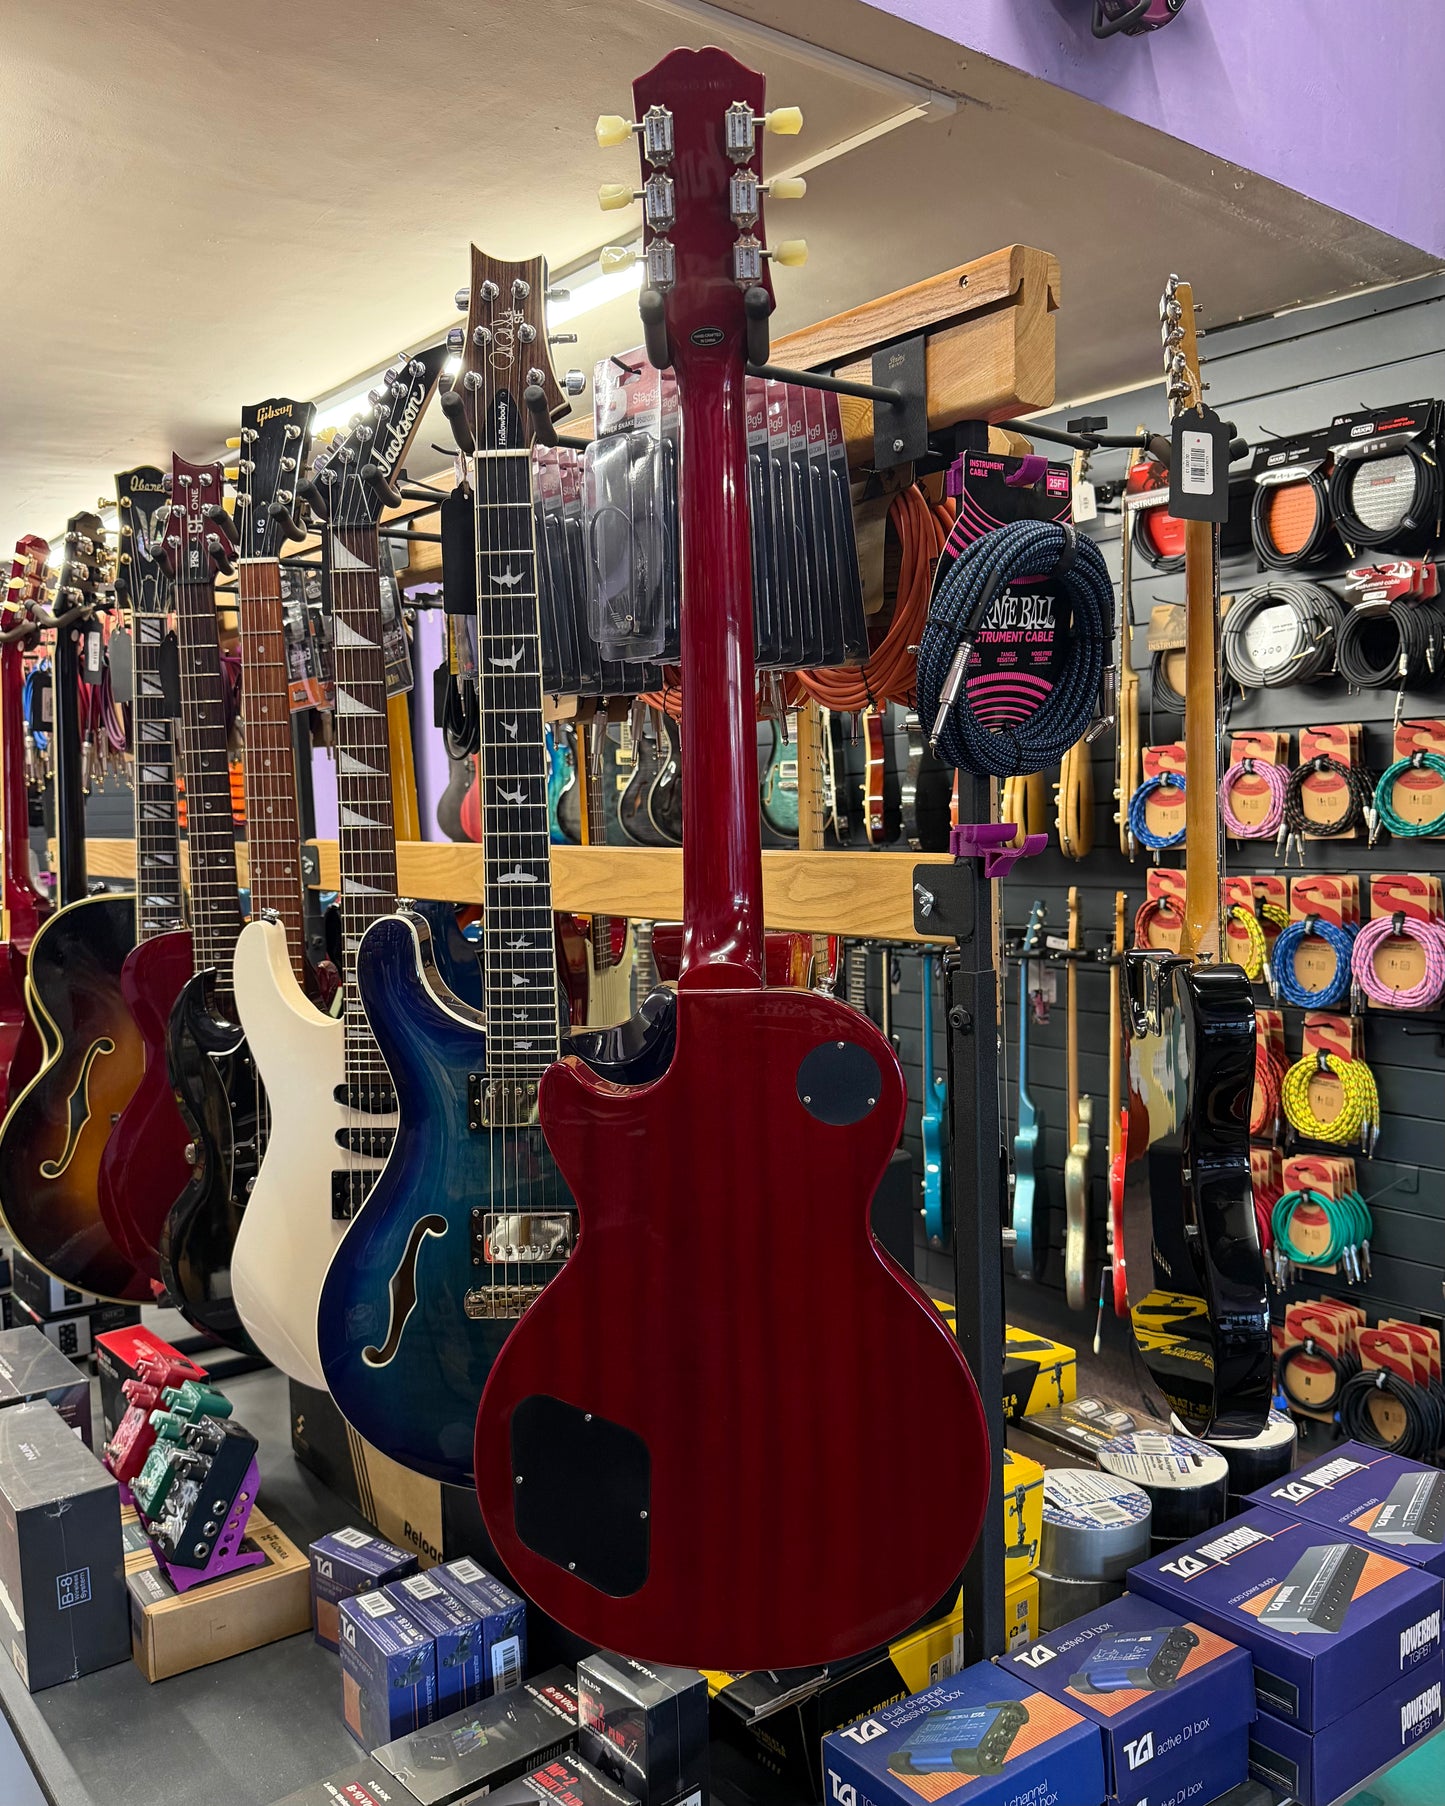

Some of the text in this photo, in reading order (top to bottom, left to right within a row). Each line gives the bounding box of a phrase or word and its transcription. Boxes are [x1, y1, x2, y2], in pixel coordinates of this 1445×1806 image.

[633, 388, 660, 407] Stagg
[256, 403, 293, 428] Gibson
[499, 401, 508, 446] Hollowbody
[371, 383, 426, 478] Jackson
[969, 459, 1005, 472] INSTRUMENT
[969, 468, 989, 478] CABLE
[1049, 478, 1066, 489] 25FT
[191, 488, 199, 511] ONE
[1127, 496, 1170, 511] INSTRUMEN
[257, 519, 266, 534] SG
[190, 551, 200, 569] PRS
[1017, 595, 1056, 630] BALL
[975, 631, 1055, 643] STRUMENT CABLE
[1270, 1481, 1315, 1502] TGI
[1351, 1505, 1365, 1517] power
[1364, 1497, 1380, 1509] supply
[315, 1554, 333, 1579] TGI
[1159, 1554, 1208, 1579] TGI
[61, 1575, 74, 1606] B-8
[80, 1571, 88, 1600] System
[1243, 1585, 1260, 1598] power
[1258, 1576, 1278, 1589] supply
[340, 1614, 357, 1649] TGI
[1013, 1644, 1058, 1668] TGI
[1056, 1634, 1085, 1654] active
[1091, 1622, 1114, 1637] box
[1409, 1644, 1432, 1665] TGIPB1
[628, 1659, 656, 1679] NUX
[564, 1683, 579, 1696] NU
[580, 1675, 602, 1694] NUX
[545, 1686, 578, 1712] B-10 Vlog
[881, 1687, 946, 1721] dual channel
[840, 1719, 889, 1745] TGI
[891, 1704, 931, 1729] passive
[941, 1690, 965, 1704] box
[1410, 1715, 1433, 1740] TGIPB1
[1123, 1717, 1211, 1771] TGI active DI box
[532, 1771, 565, 1796] MIGHTY
[544, 1762, 579, 1787] MP-2
[345, 1784, 366, 1803] B-10
[368, 1780, 392, 1802] NUX
[828, 1768, 857, 1806] TGI
[1011, 1778, 1049, 1806] channel
[1038, 1790, 1059, 1805] box
[1186, 1780, 1204, 1796] box
